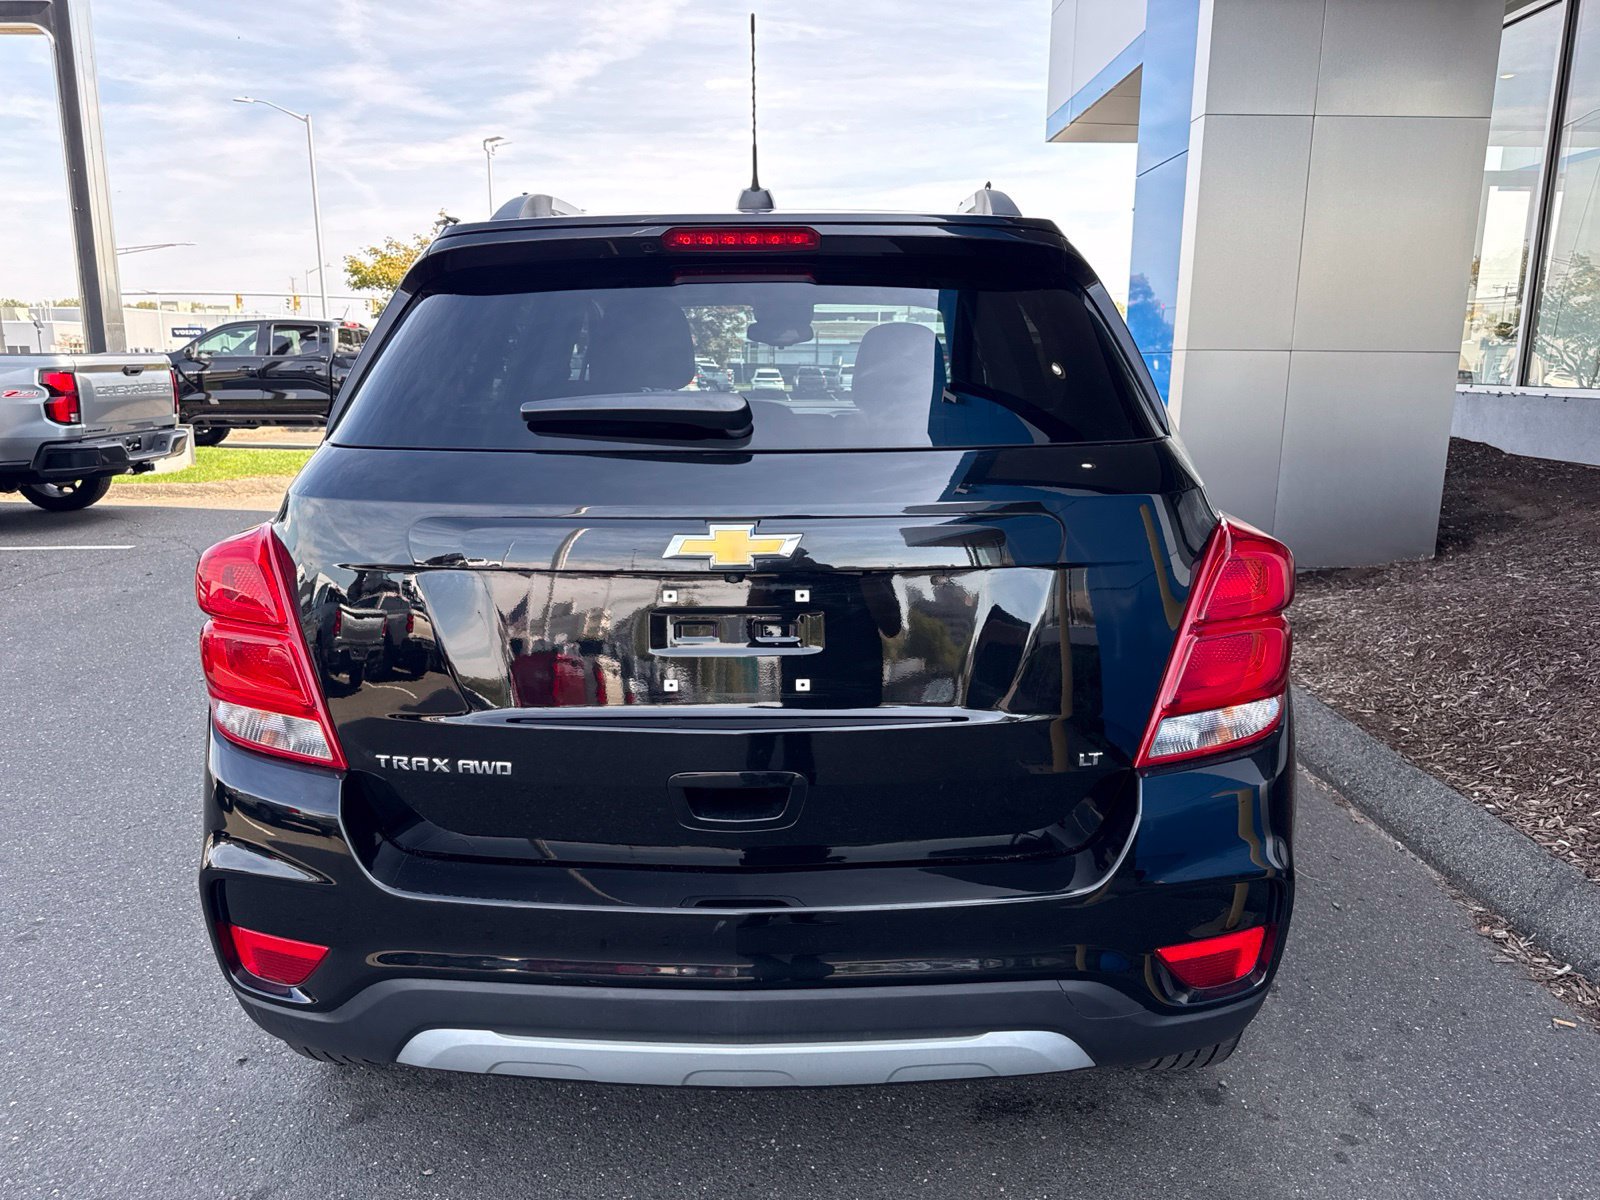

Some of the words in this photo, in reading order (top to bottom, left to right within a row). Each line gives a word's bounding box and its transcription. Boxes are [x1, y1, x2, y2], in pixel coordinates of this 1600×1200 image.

[96, 383, 170, 397] CHEVROLET
[375, 754, 451, 773] TRAX
[457, 759, 512, 776] AWD
[1079, 752, 1103, 767] LT
